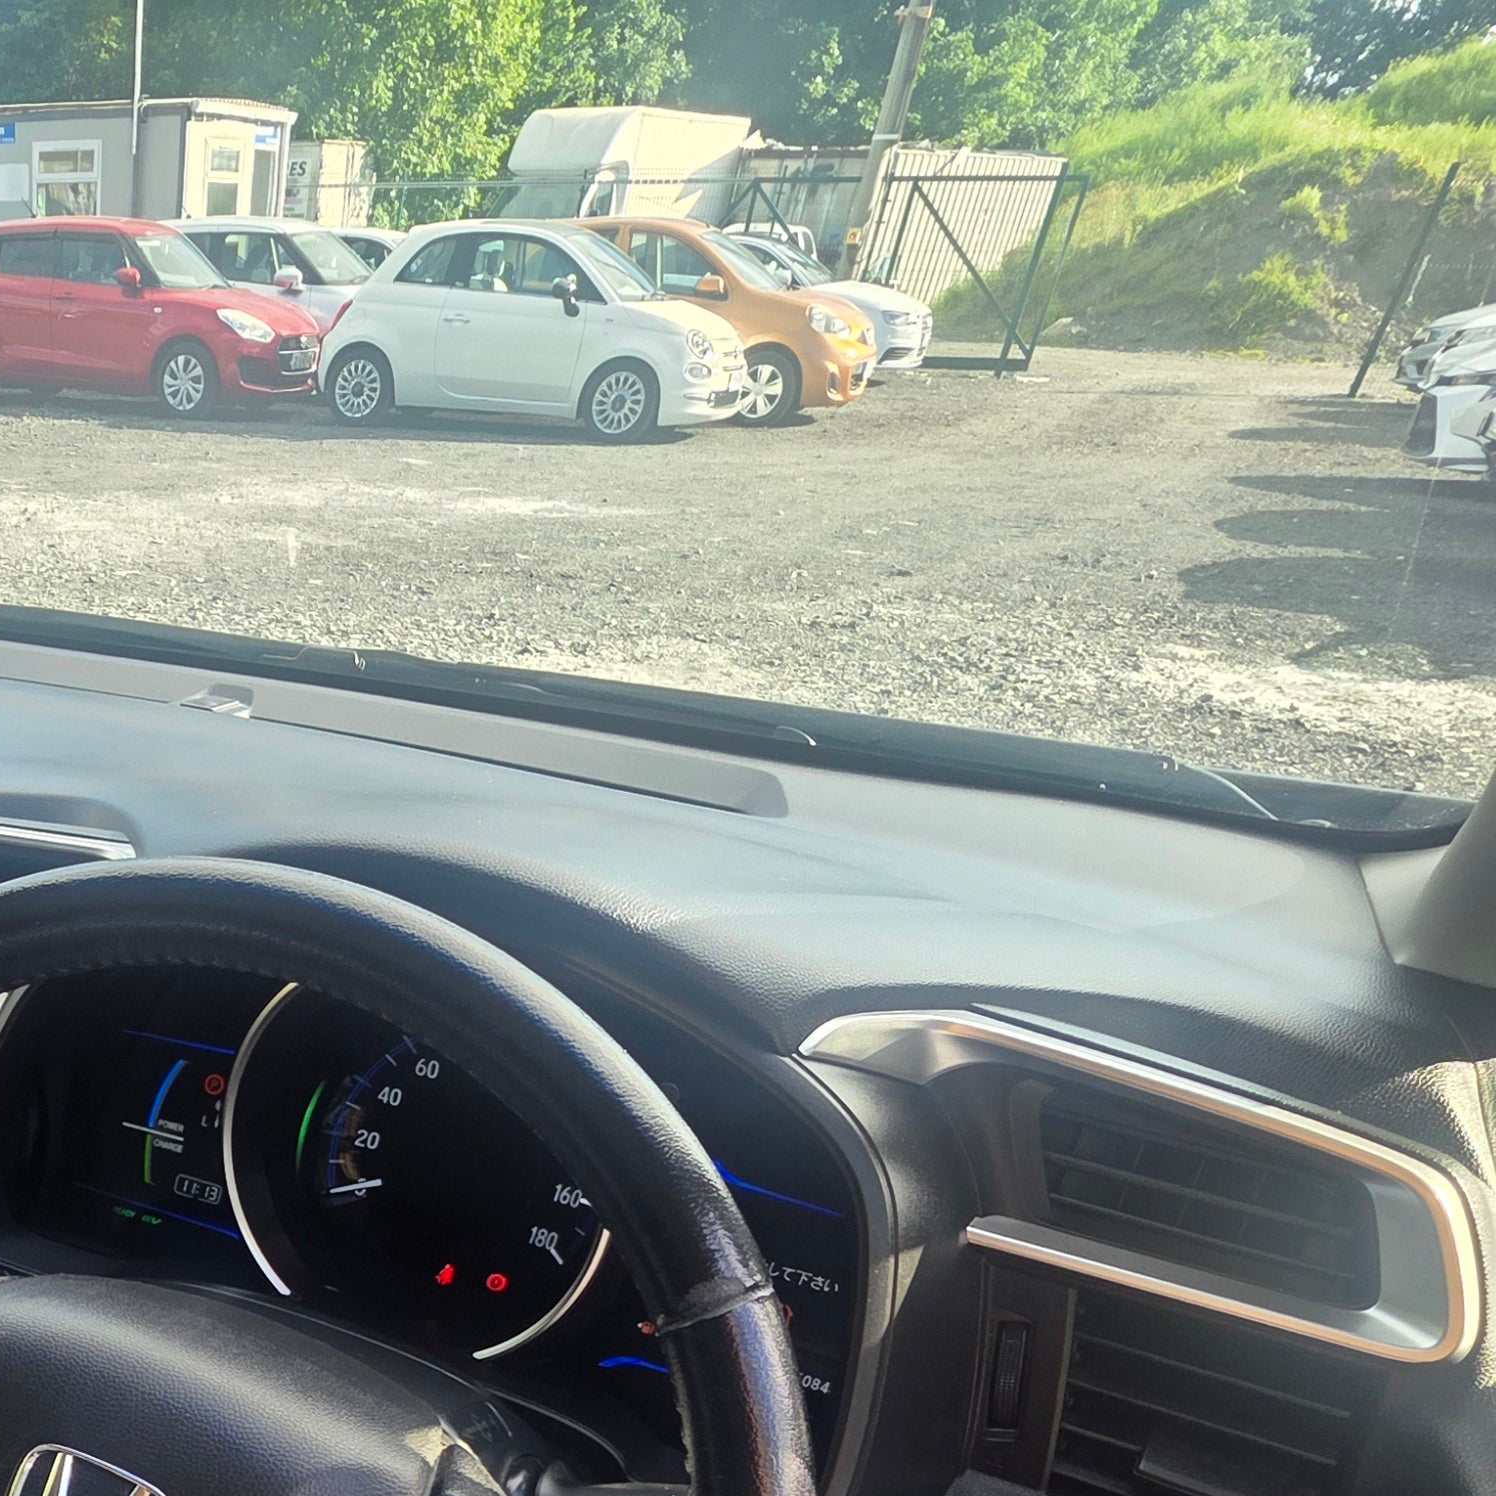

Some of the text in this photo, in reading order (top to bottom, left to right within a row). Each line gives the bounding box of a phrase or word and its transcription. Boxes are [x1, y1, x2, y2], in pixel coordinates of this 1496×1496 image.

[287, 161, 307, 177] ES
[415, 1058, 440, 1079] 60
[377, 1086, 402, 1106] 40
[157, 1118, 185, 1133] POWER
[153, 1138, 184, 1154] CHARGE
[354, 1129, 380, 1150] 20
[553, 1183, 583, 1208] 160
[529, 1225, 559, 1250] 180
[768, 1261, 839, 1293] して下さい
[800, 1373, 831, 1394] 084
